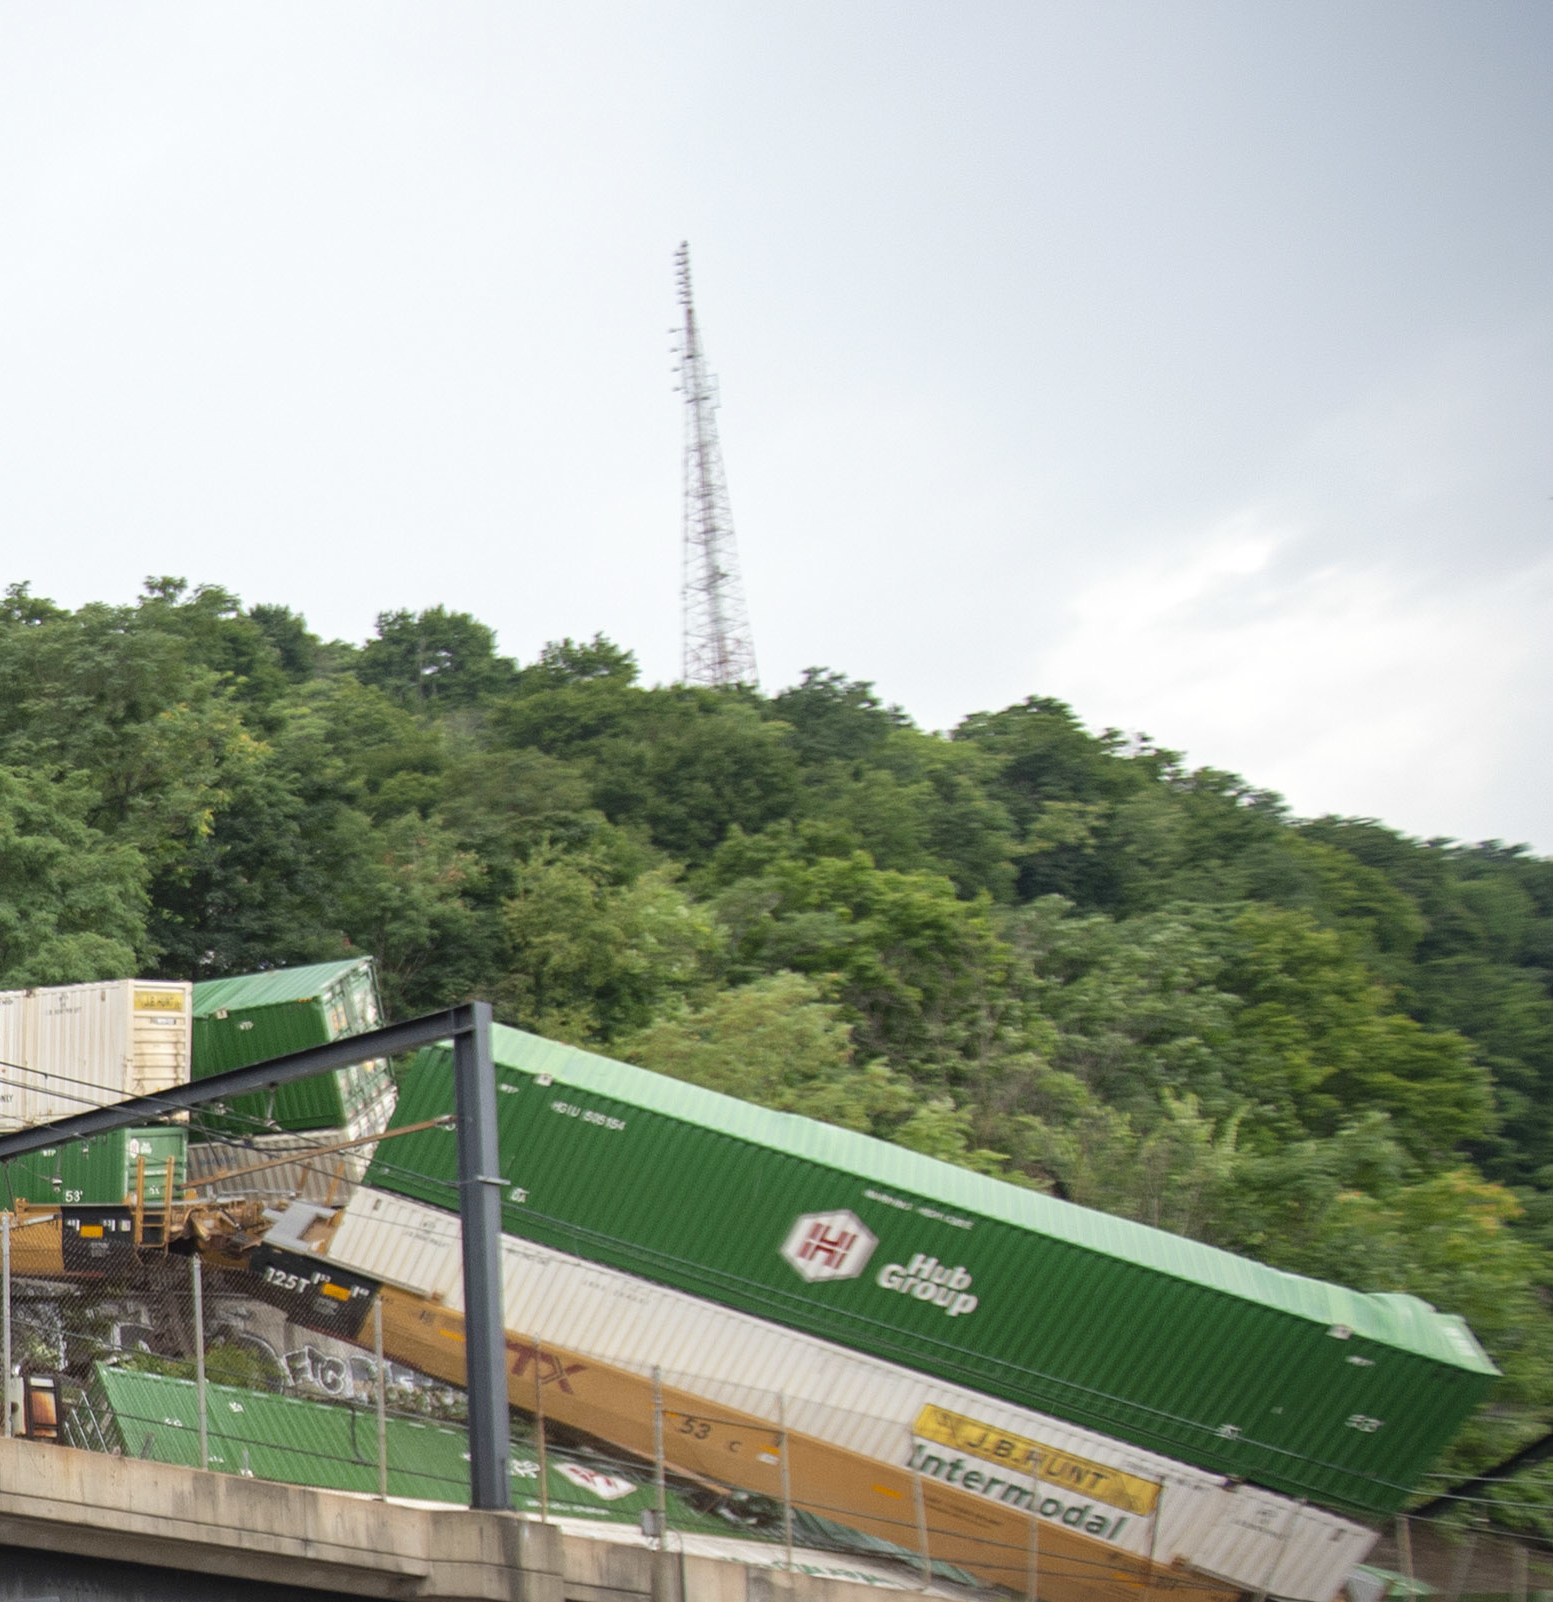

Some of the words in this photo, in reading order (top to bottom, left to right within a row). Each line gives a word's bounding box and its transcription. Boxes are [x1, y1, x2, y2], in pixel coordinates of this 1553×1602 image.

[65, 1190, 83, 1202] 53'
[265, 1266, 309, 1293] 125T
[906, 1253, 972, 1290] Hub
[875, 1263, 979, 1316] Group
[1024, 1450, 1110, 1485] HUNT
